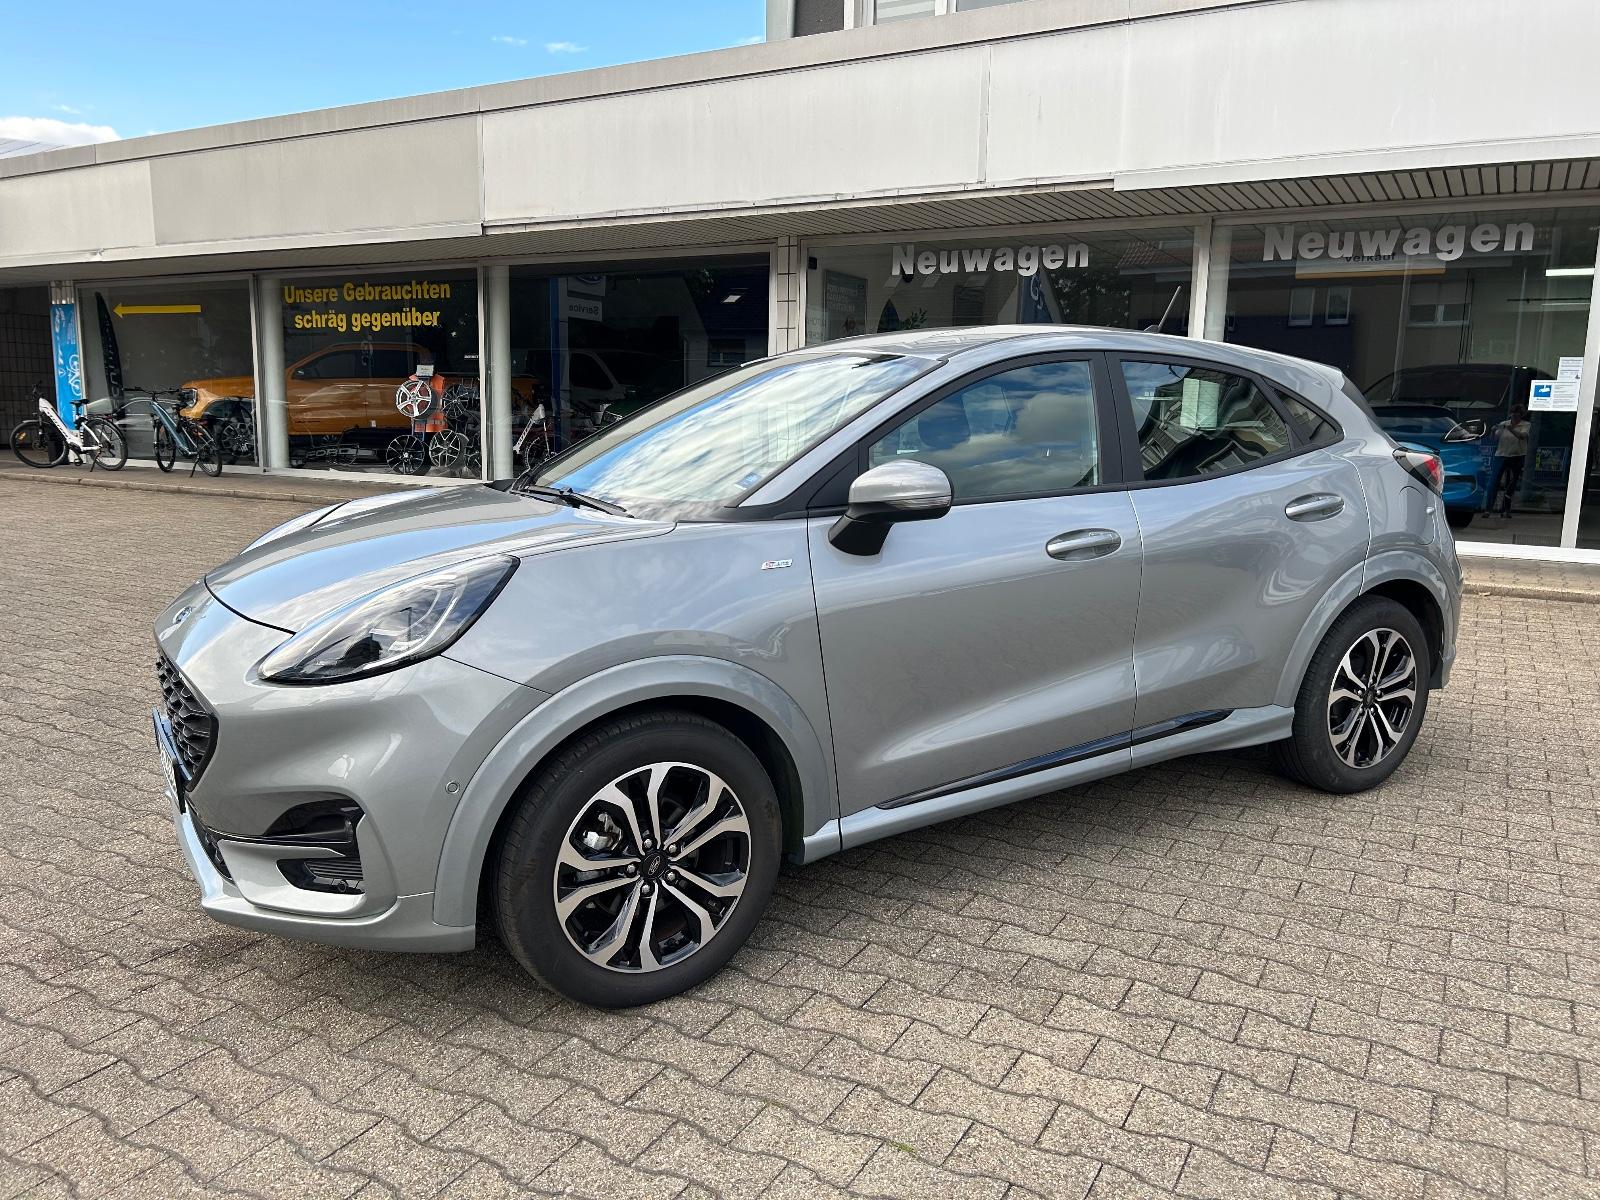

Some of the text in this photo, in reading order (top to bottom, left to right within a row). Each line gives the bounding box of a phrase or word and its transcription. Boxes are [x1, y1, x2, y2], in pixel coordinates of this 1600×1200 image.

[1263, 222, 1535, 261] Neuwagen
[891, 241, 1090, 277] Neuwagen
[284, 280, 451, 304] Unsere Gebrauchten
[294, 307, 440, 333] schräg gegenüber
